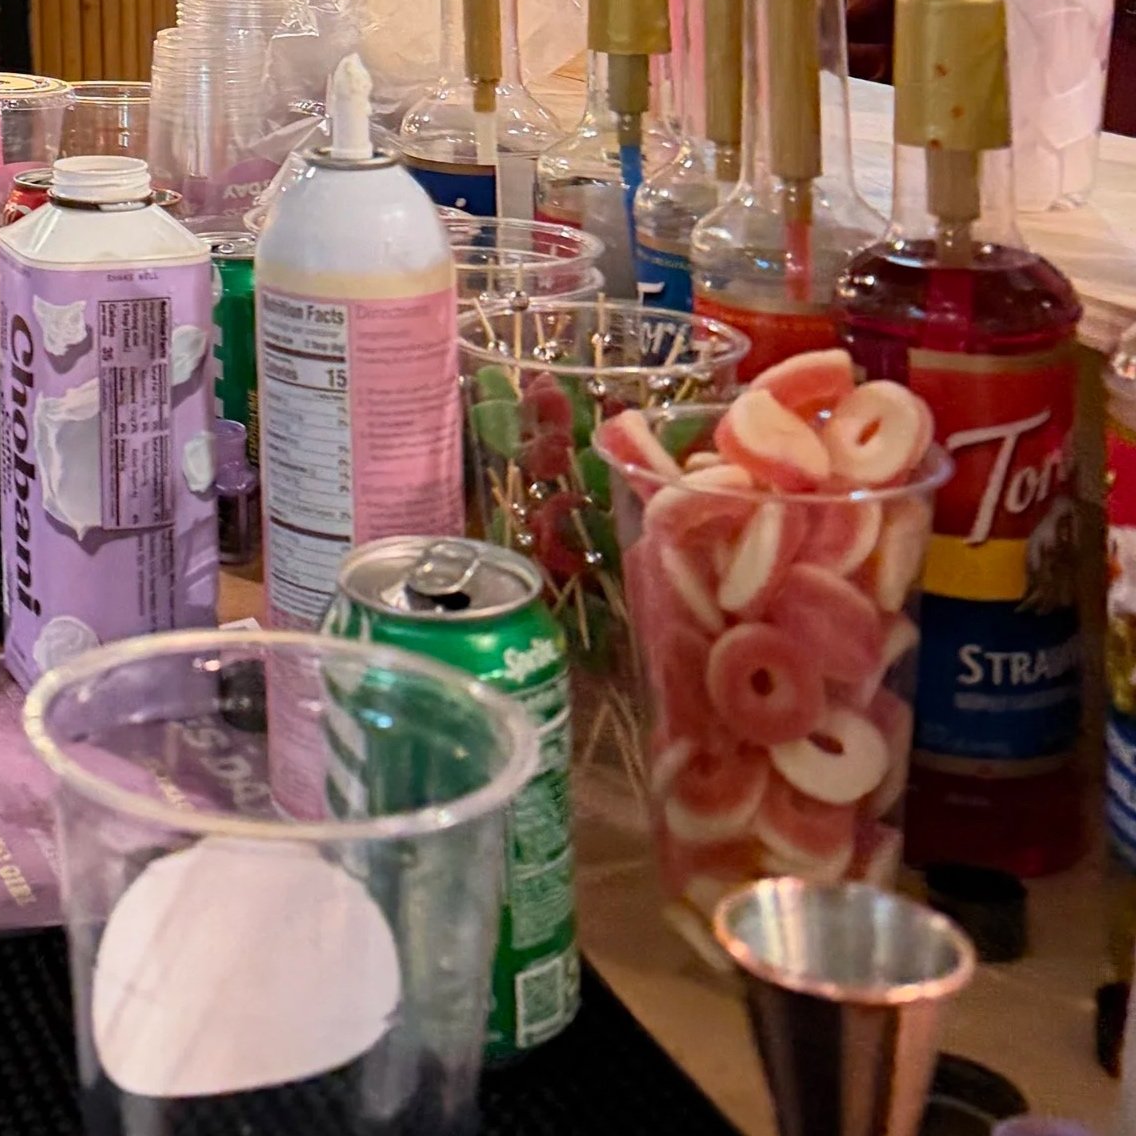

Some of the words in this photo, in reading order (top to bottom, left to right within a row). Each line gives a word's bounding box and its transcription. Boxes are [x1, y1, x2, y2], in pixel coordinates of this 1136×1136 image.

[109, 303, 117, 338] Calories
[307, 304, 344, 325] Facts
[102, 347, 114, 361] 35
[326, 369, 347, 389] 15
[11, 314, 41, 616] Chobani
